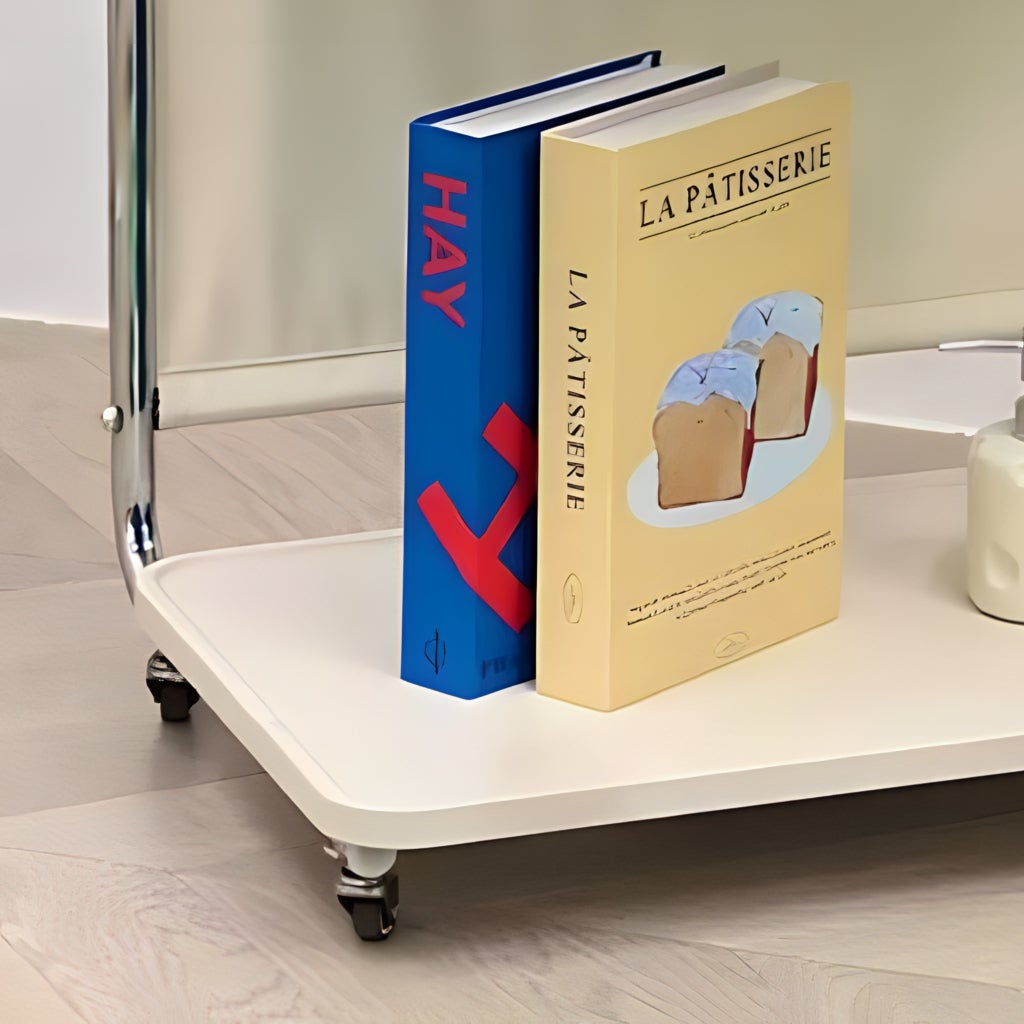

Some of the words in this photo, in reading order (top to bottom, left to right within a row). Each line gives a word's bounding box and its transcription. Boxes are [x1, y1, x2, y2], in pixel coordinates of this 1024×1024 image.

[639, 194, 676, 228] LA
[685, 140, 832, 214] PÂTISSERIE
[420, 171, 468, 329] HAY
[567, 268, 589, 310] LA
[565, 325, 592, 511] PÂTISSERIE
